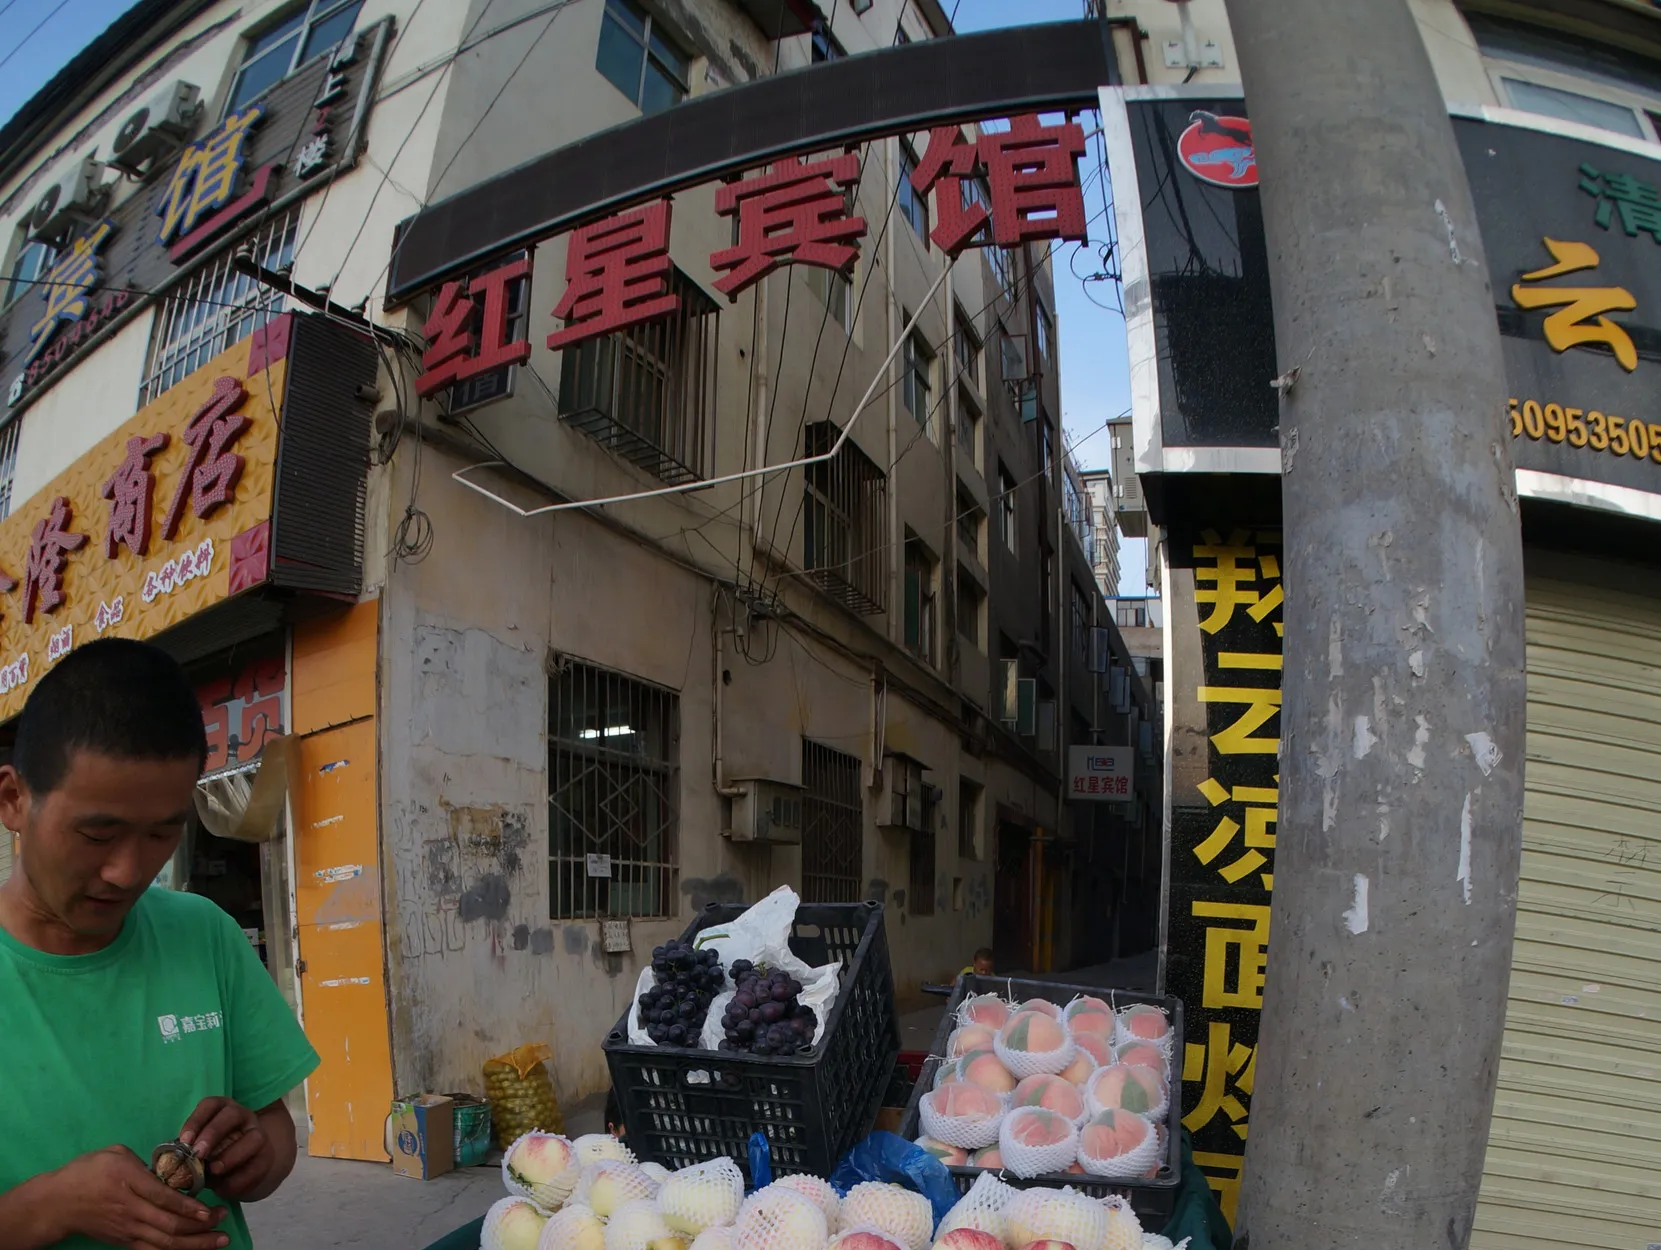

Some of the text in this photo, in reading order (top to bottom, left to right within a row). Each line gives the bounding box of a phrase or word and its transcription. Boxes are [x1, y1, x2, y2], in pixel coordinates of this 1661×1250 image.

[24, 103, 265, 368] 宾馆
[415, 111, 1089, 401] 红星宾馆
[1511, 236, 1638, 374] 云
[0, 375, 251, 625] 隆商店
[142, 539, 214, 603] 各种饮料
[1073, 775, 1129, 794] 红星宾馆
